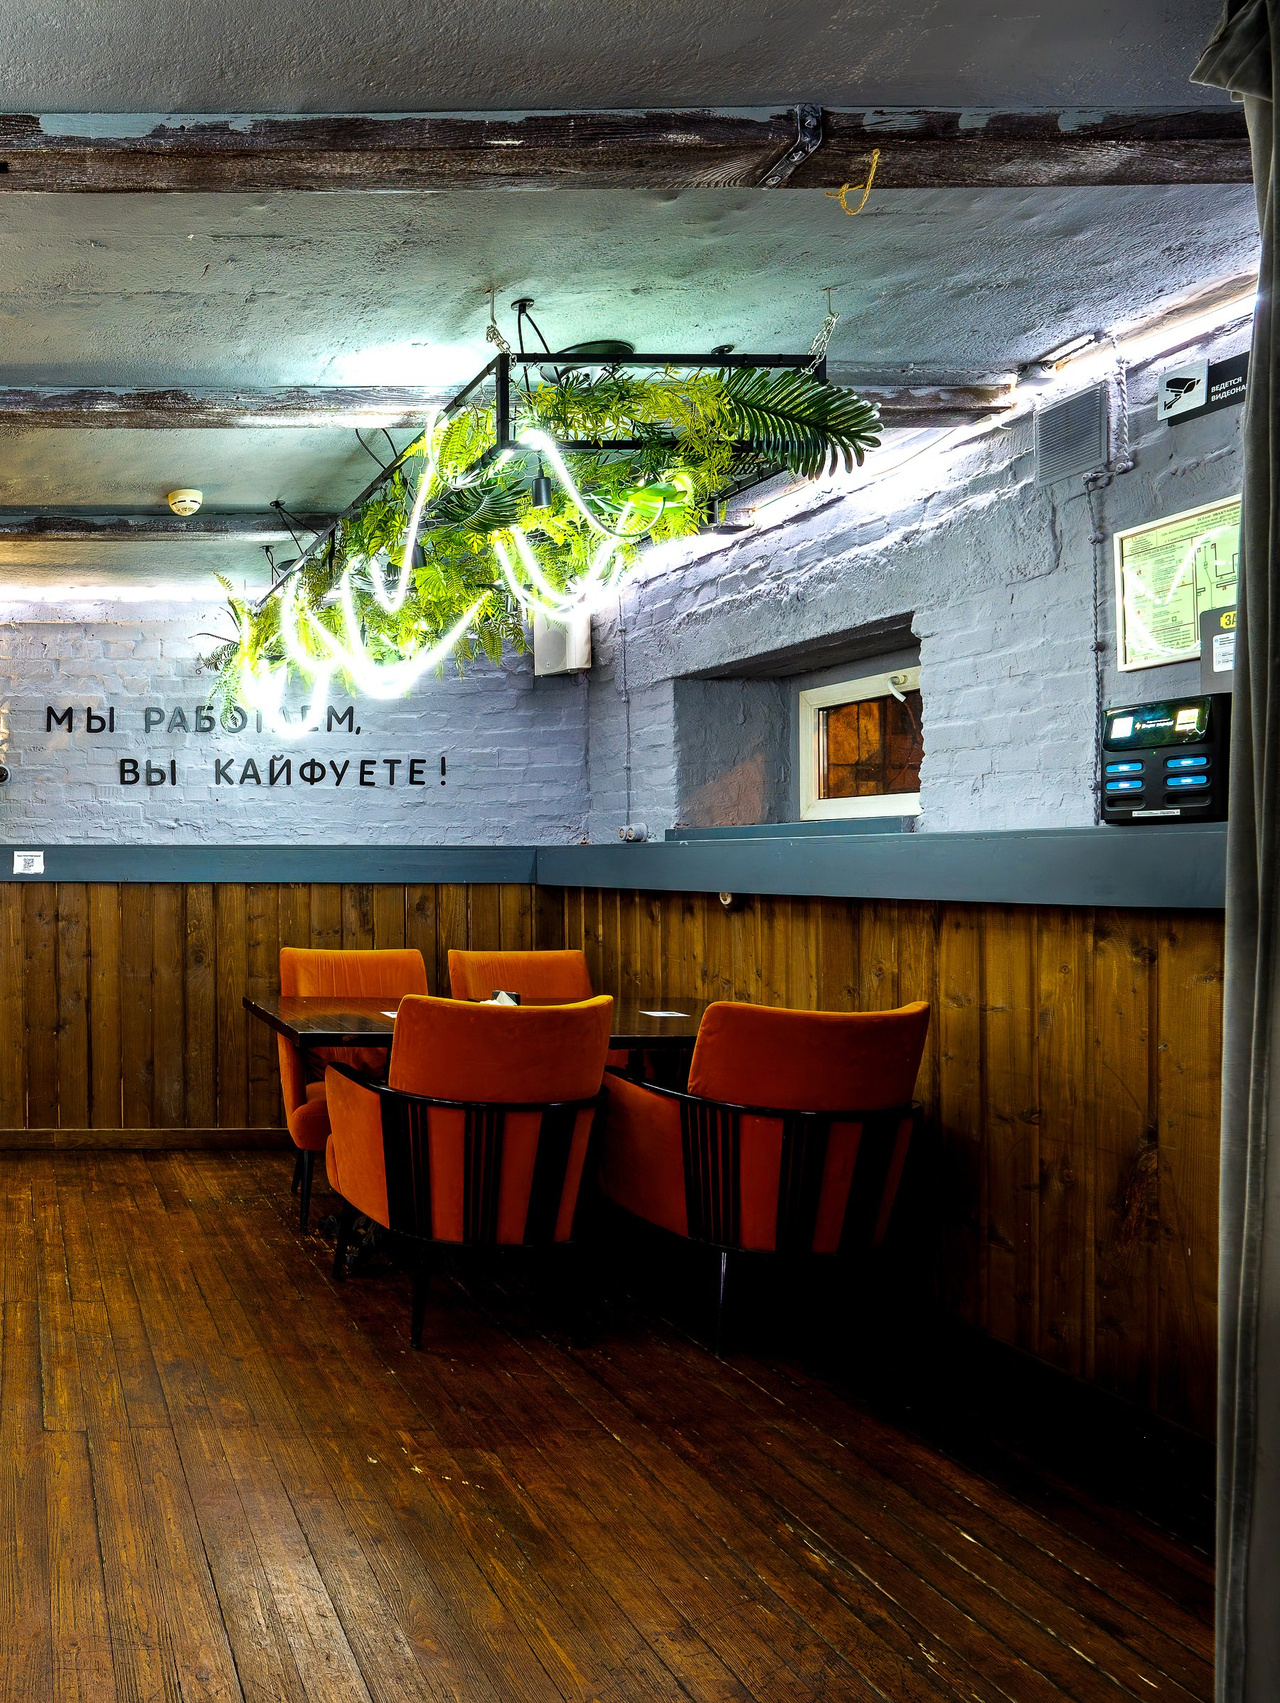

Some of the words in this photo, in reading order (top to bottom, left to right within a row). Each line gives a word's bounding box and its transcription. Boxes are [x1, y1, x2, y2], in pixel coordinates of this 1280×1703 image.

[1211, 376, 1243, 393] ВЕДЕТСЯ
[1211, 383, 1248, 402] ВИДЕОНА
[46, 705, 115, 733] МЫ
[119, 758, 177, 786] ВЫ
[215, 754, 447, 786] КАЙФУЕТЕ!
